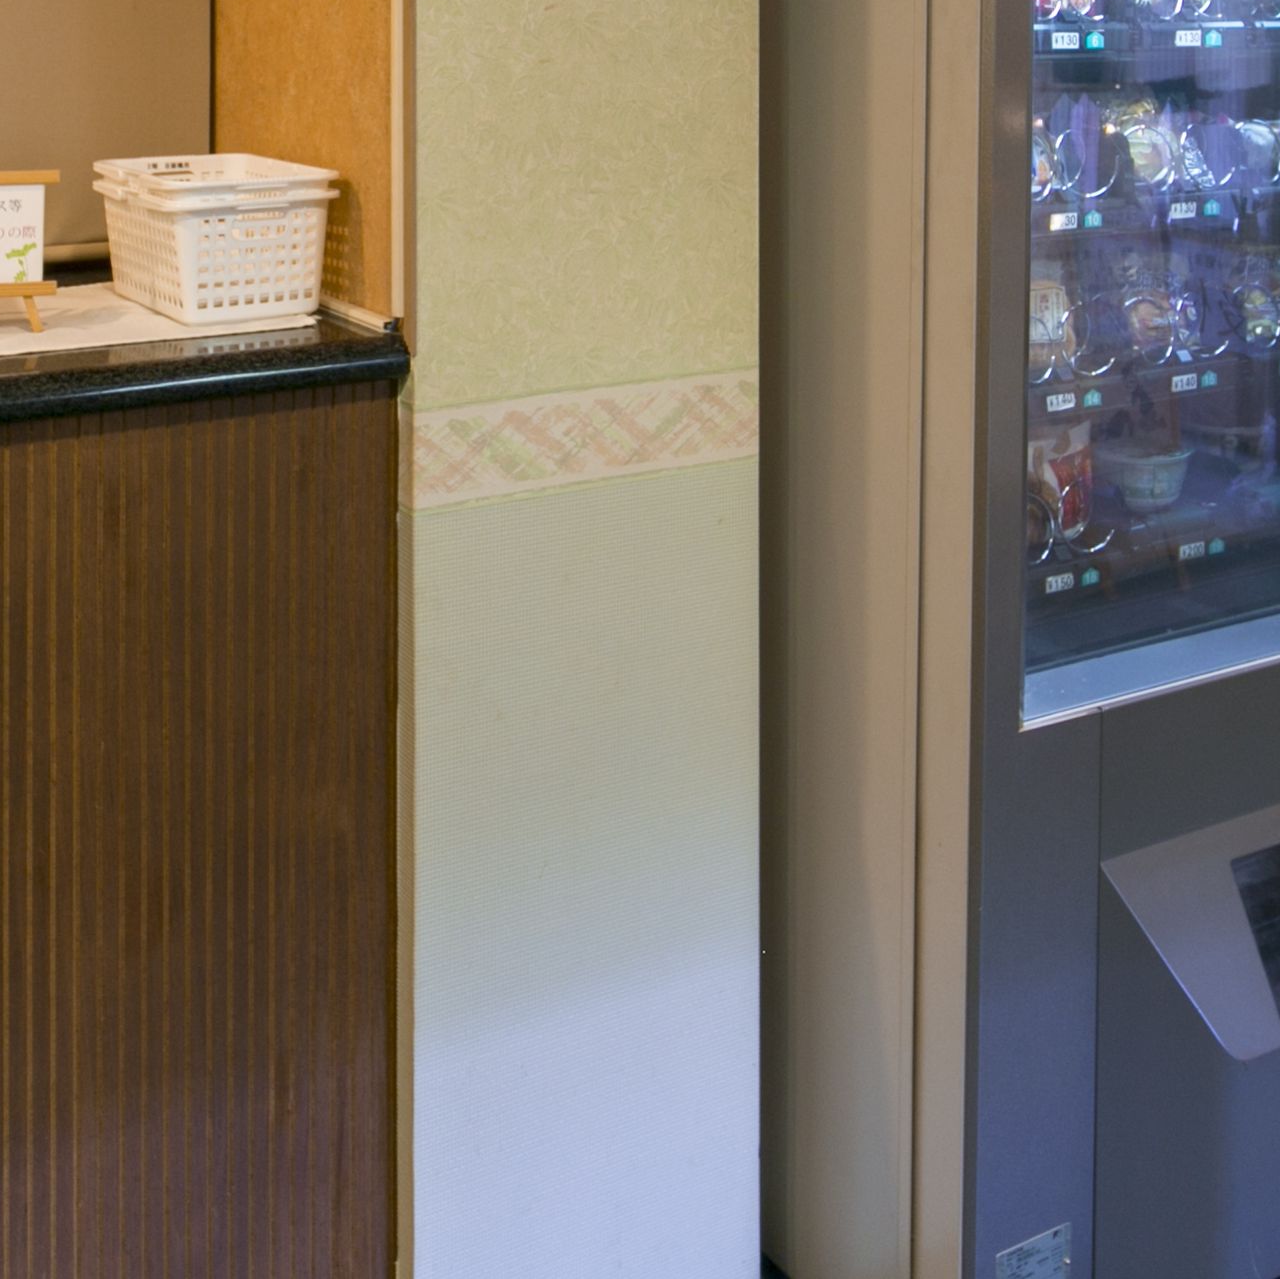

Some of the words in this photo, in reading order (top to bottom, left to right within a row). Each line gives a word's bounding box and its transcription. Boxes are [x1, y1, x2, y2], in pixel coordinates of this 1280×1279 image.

[1054, 34, 1078, 48] ¥130
[1092, 35, 1100, 47] 6
[1177, 31, 1201, 45] ¥130
[1172, 203, 1196, 217] ¥130
[1087, 215, 1100, 226] 10
[1173, 375, 1196, 390] ¥140
[1048, 394, 1074, 409] ¥140
[1087, 393, 1099, 406] 14
[1180, 543, 1205, 558] ¥200
[1047, 575, 1073, 591] ¥150
